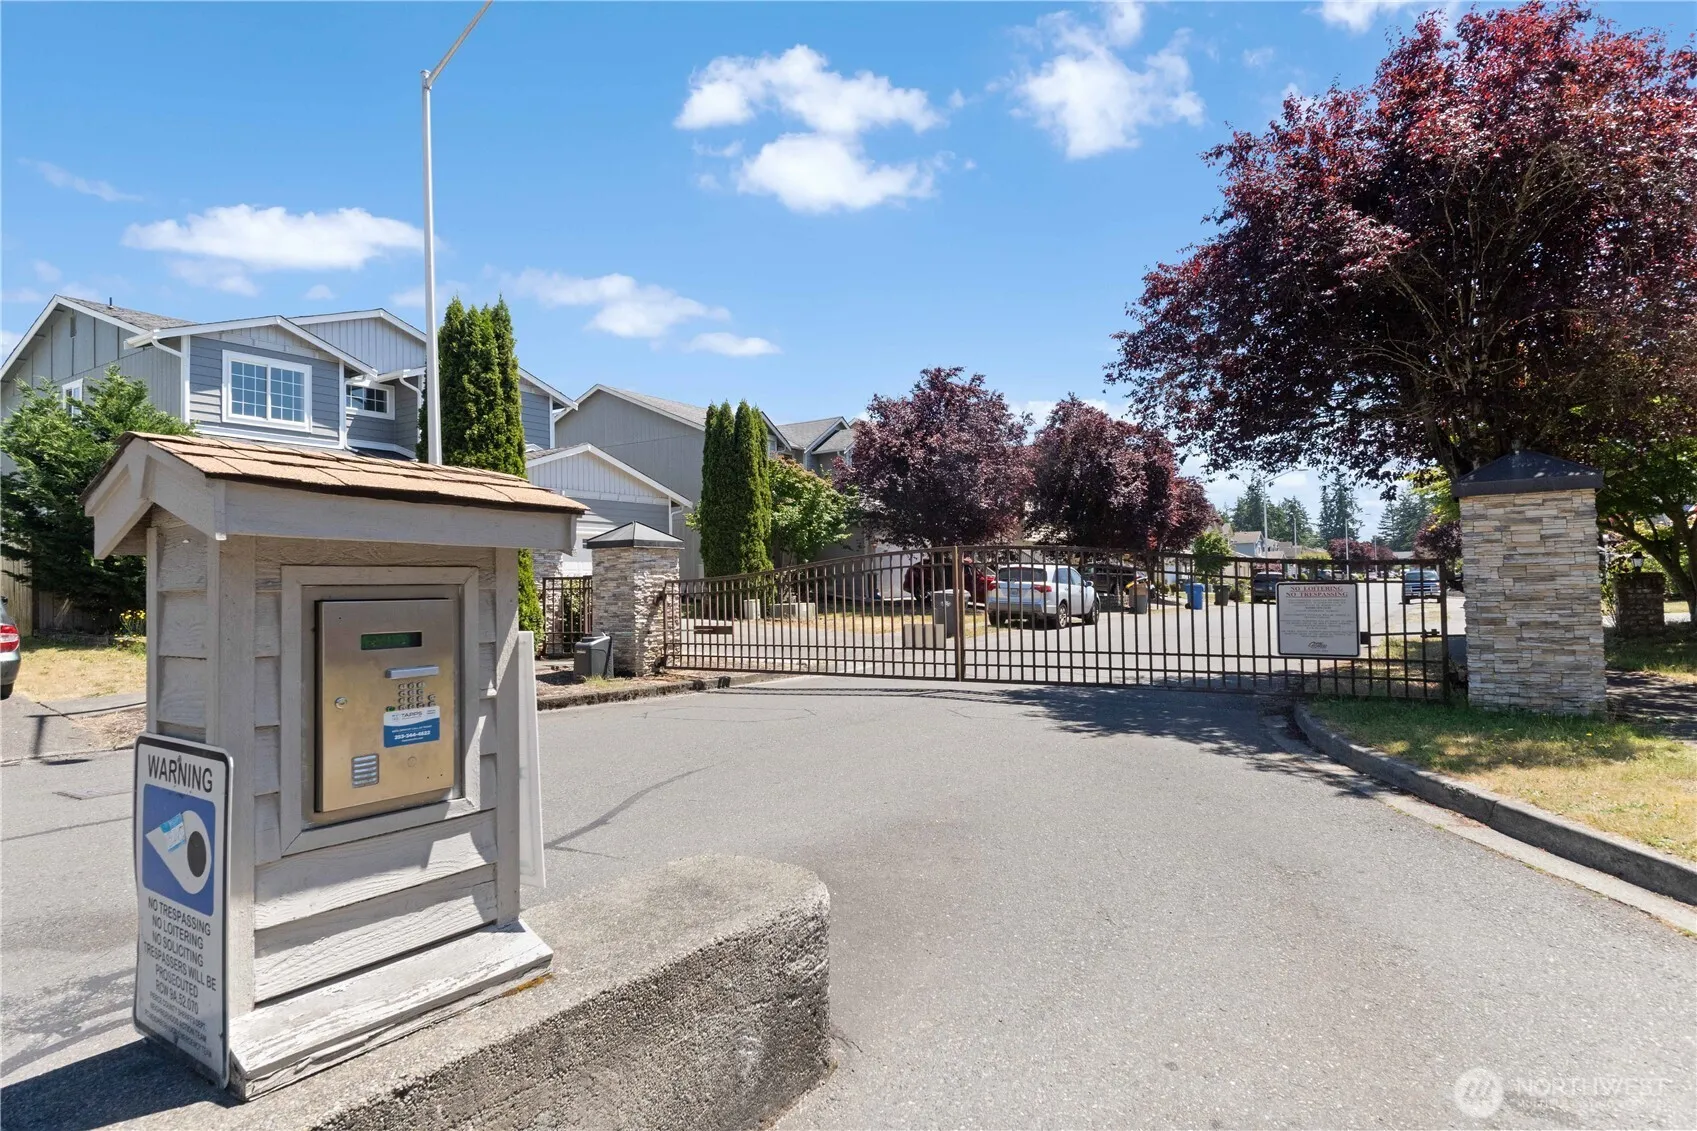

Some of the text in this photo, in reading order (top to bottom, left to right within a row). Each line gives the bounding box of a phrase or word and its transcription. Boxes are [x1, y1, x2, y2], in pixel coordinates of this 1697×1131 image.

[148, 754, 213, 793] WARNING
[148, 897, 211, 936] NO TRESPASSING
[152, 915, 204, 950] NO LOITERING
[143, 941, 217, 992] TRESPASSERS WILL BE
[152, 931, 204, 967] NO SOLICITING
[155, 964, 199, 998] PROSECUTED
